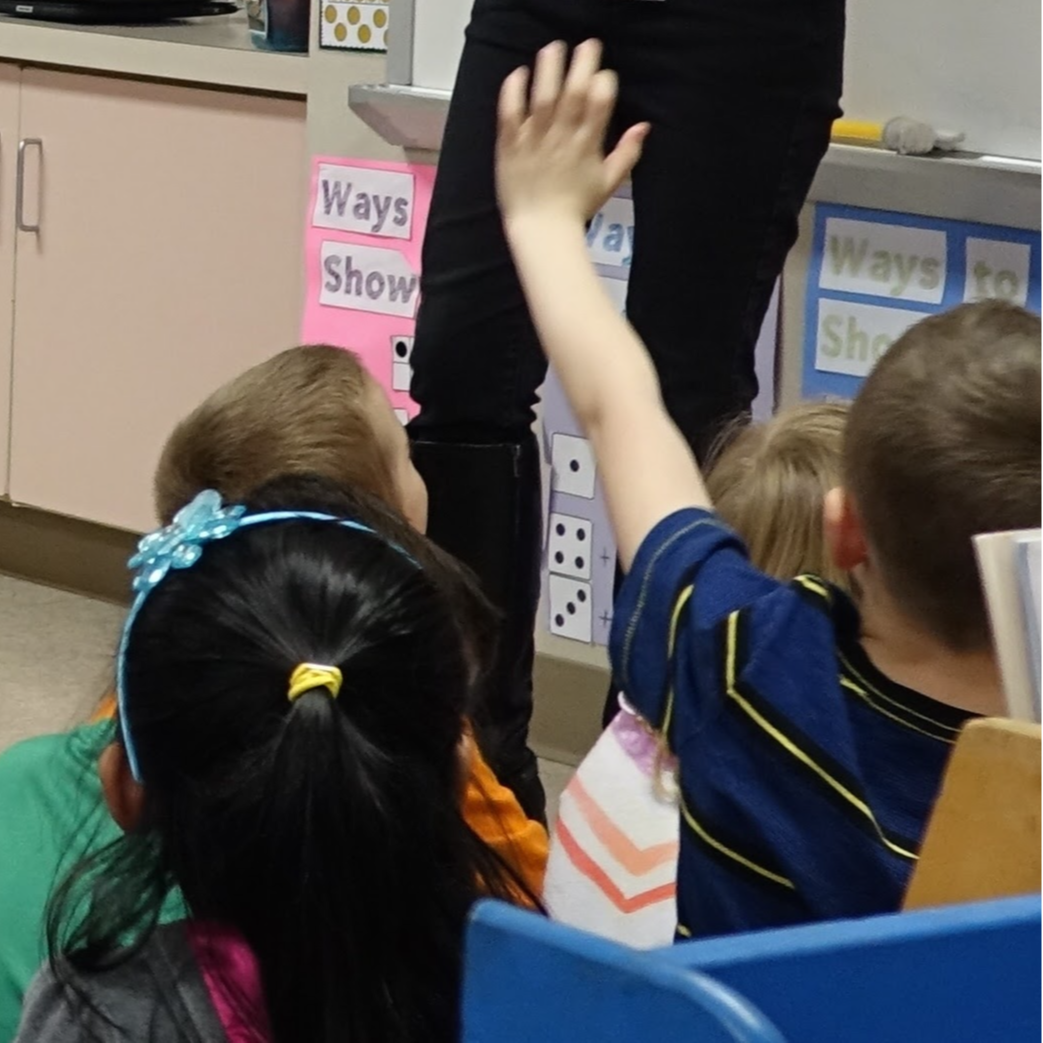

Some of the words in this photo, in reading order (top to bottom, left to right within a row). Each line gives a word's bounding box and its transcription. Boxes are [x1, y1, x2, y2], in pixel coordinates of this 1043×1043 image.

[322, 178, 410, 234] Ways
[324, 254, 420, 304] Show
[828, 235, 941, 297] Ways
[973, 260, 1020, 300] to
[820, 313, 892, 362] Sho
